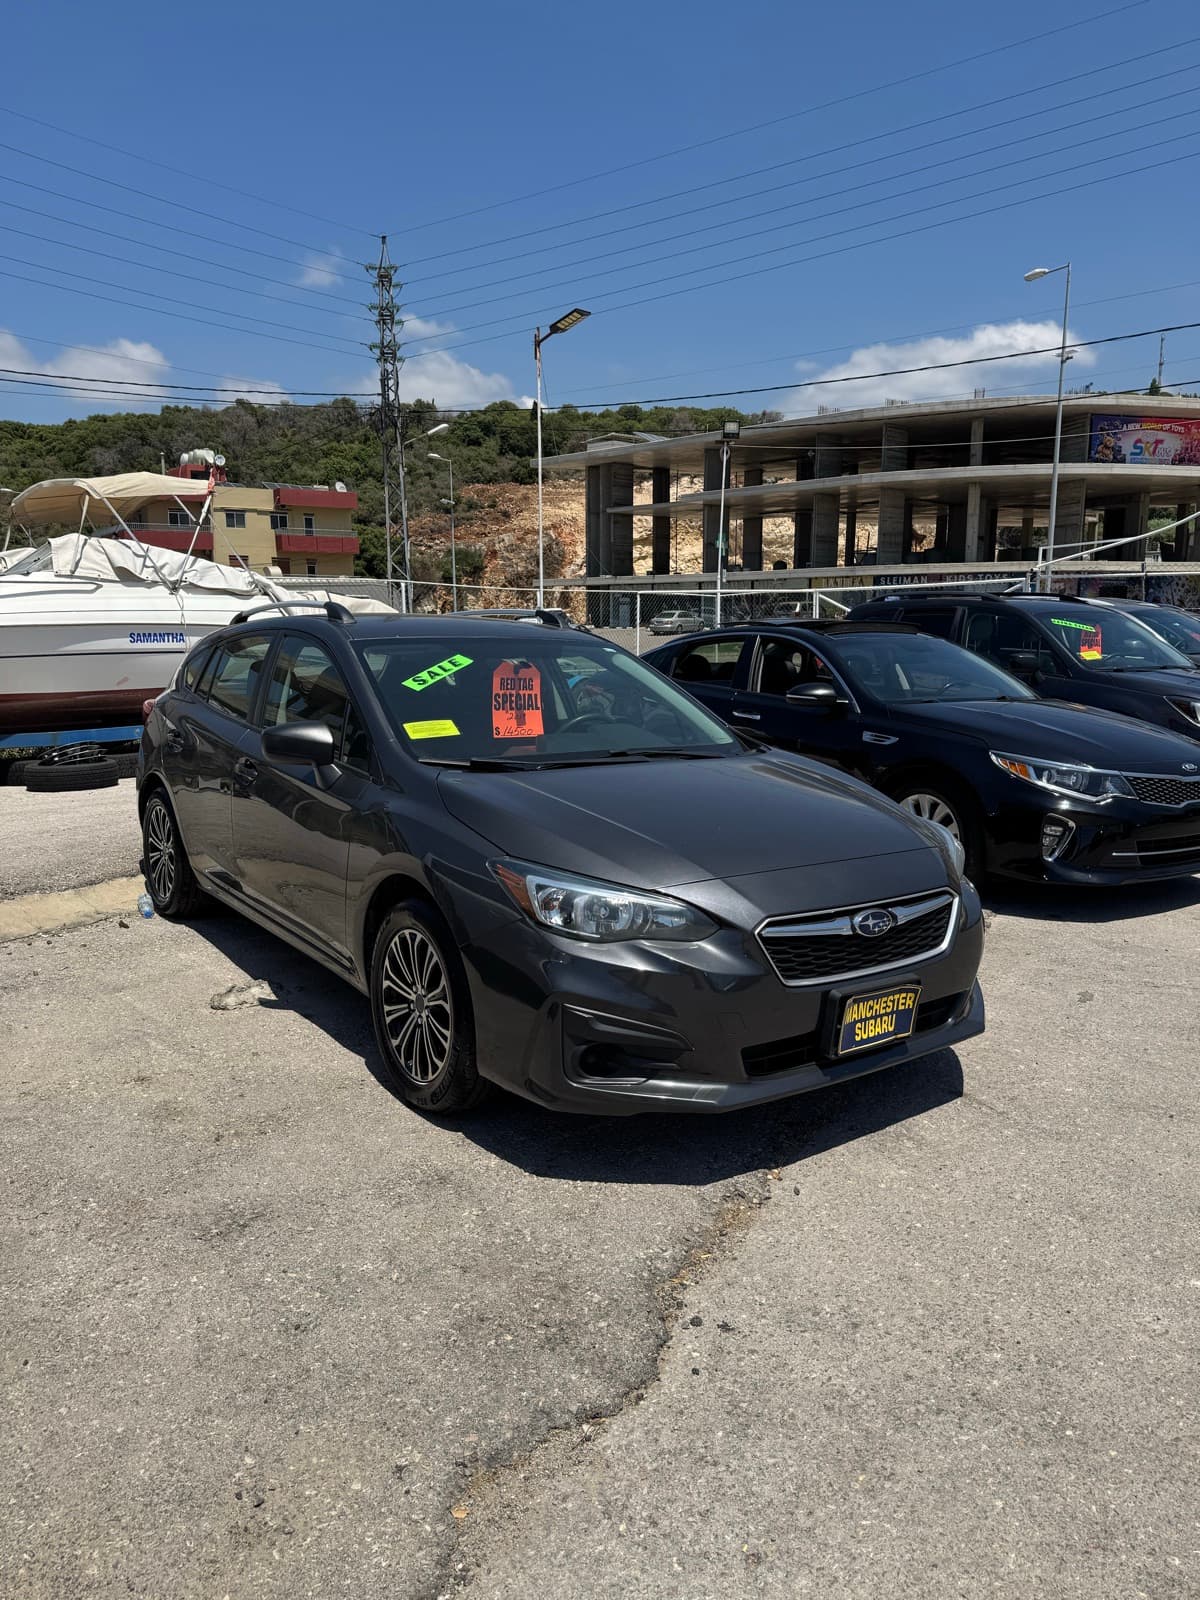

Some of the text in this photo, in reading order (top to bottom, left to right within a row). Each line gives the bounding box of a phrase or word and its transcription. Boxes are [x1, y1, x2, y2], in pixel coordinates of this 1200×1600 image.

[1163, 424, 1171, 432] OF
[1172, 425, 1185, 433] TOYS
[880, 576, 928, 585] SLEIMAN
[129, 632, 185, 643] SAMANTHA
[411, 658, 464, 686] SALE
[500, 678, 534, 691] RED TAG
[494, 693, 540, 711] SPECIAL
[845, 992, 915, 1025] MANCHESTER
[855, 1014, 896, 1042] SUBARU
